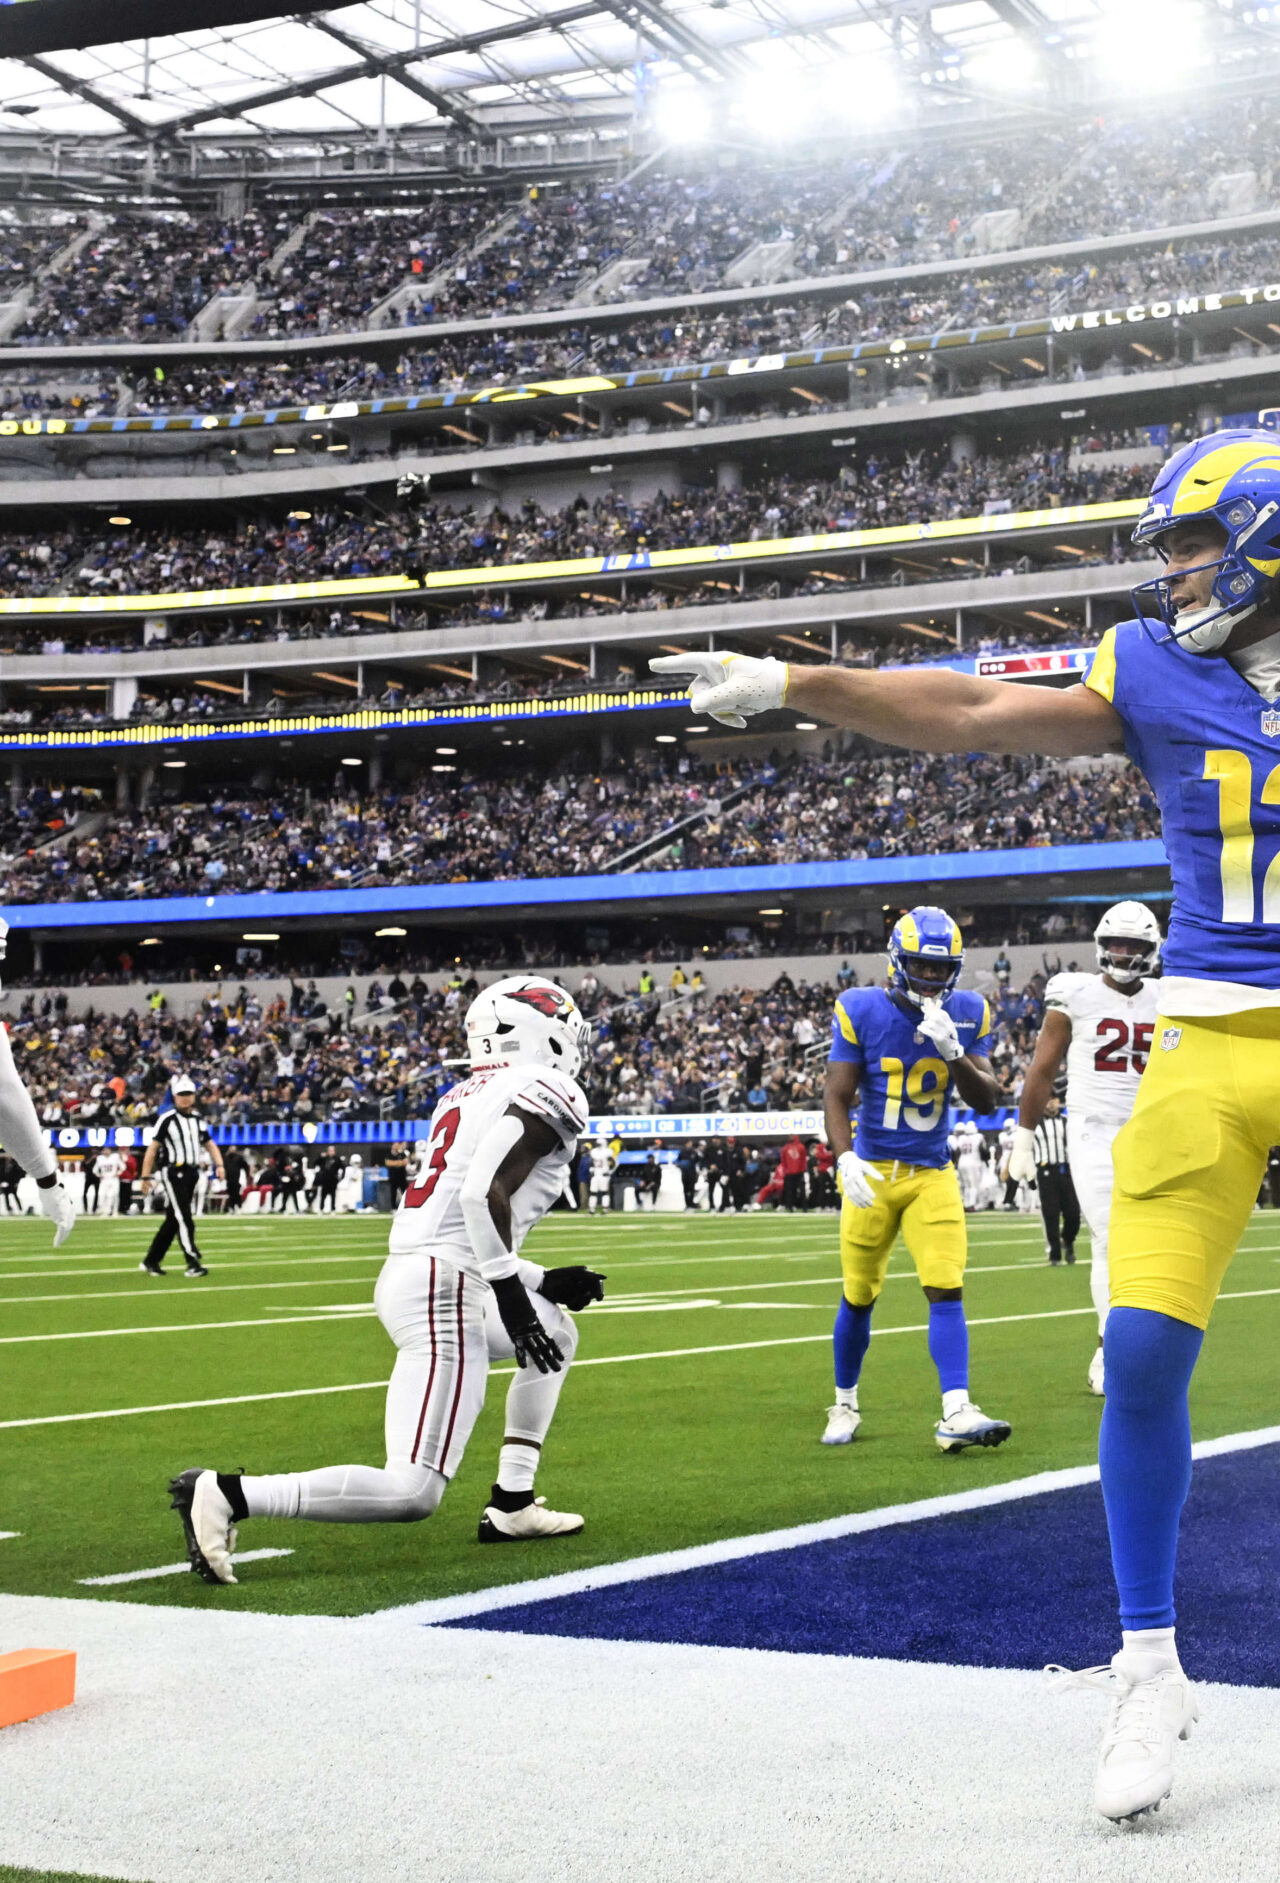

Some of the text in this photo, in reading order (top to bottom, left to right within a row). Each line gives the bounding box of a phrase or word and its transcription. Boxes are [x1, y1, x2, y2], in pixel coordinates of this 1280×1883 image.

[1051, 294, 1222, 332] WELCOME
[1265, 721, 1280, 732] NFL
[482, 1038, 492, 1054] 3
[1095, 1018, 1155, 1074] 25
[1163, 1037, 1176, 1047] NFL
[536, 1091, 580, 1135] CARDIN
[880, 1056, 950, 1132] 19
[404, 1106, 461, 1208] 3
